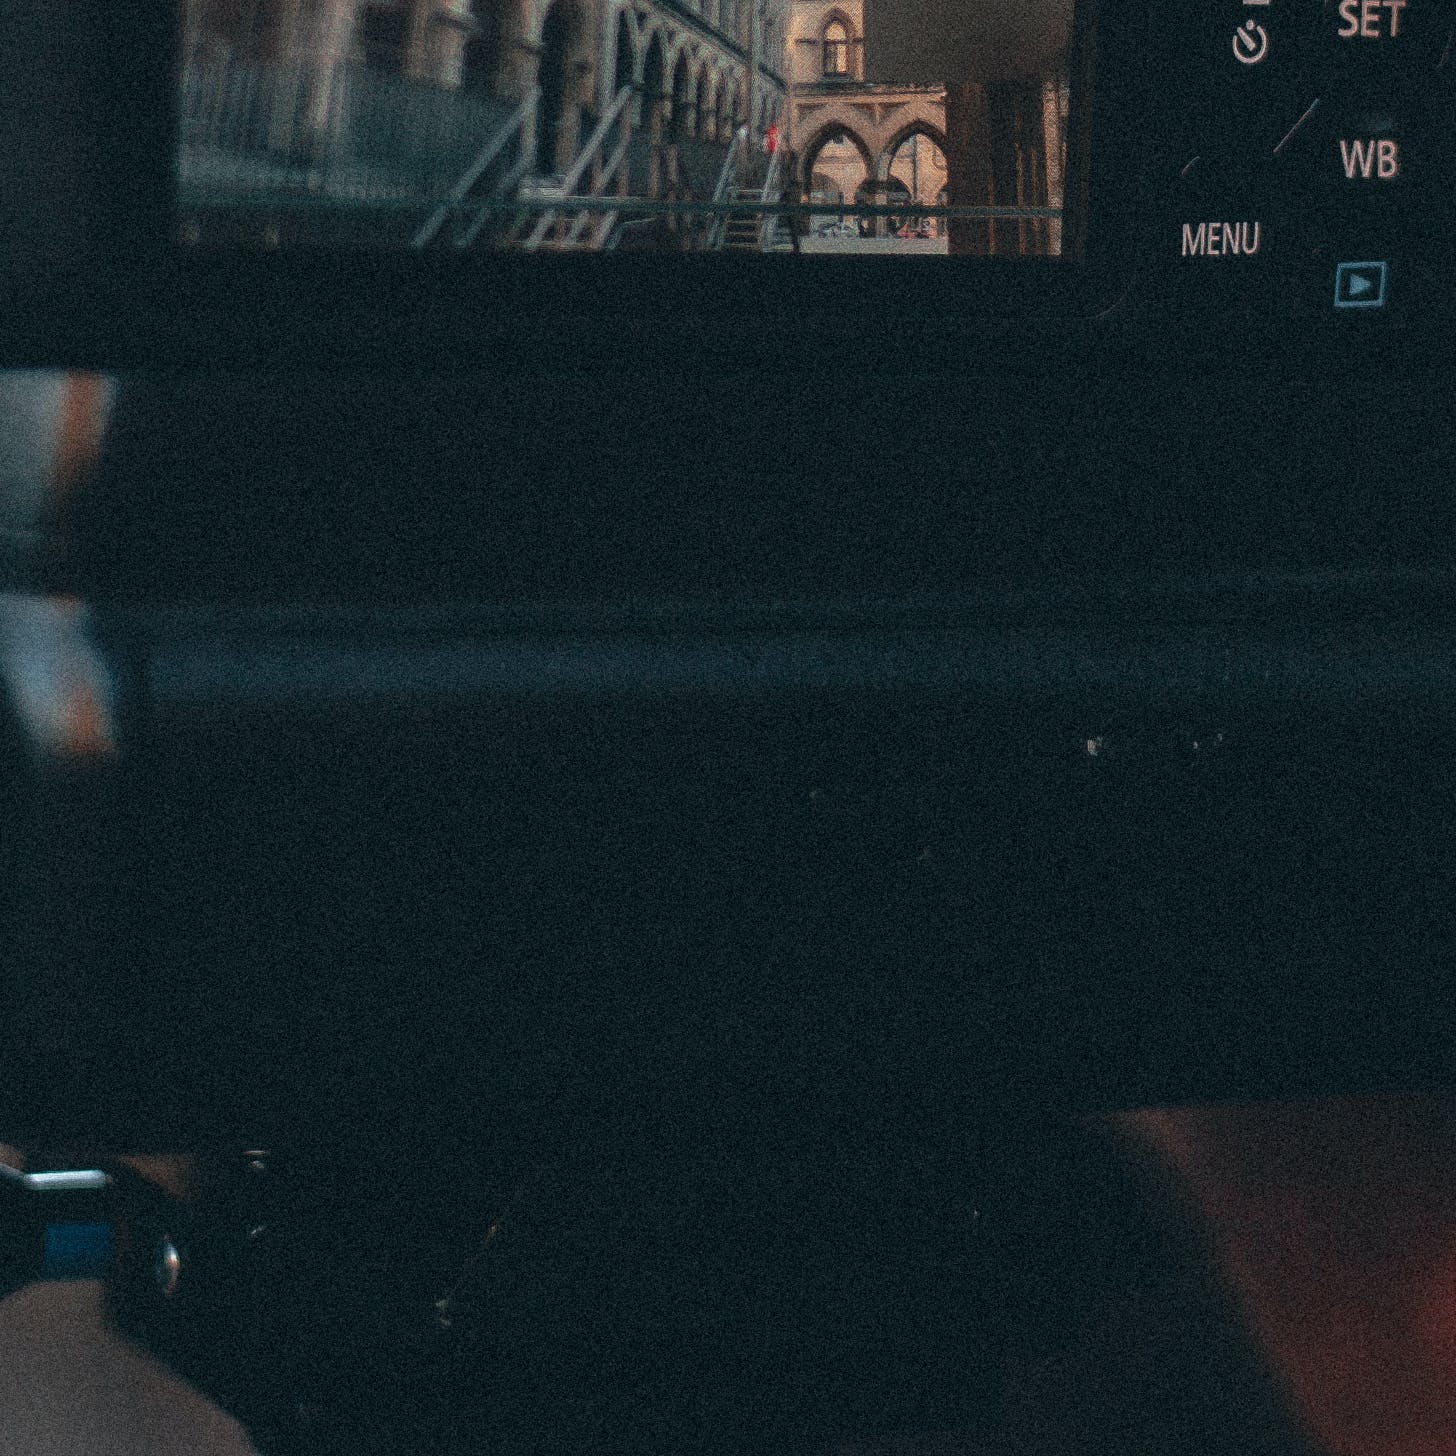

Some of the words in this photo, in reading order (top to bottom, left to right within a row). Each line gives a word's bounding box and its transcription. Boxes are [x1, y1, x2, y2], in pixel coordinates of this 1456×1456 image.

[1338, 0, 1406, 38] SET
[1340, 141, 1398, 178] WB
[1181, 222, 1260, 255] MENU
